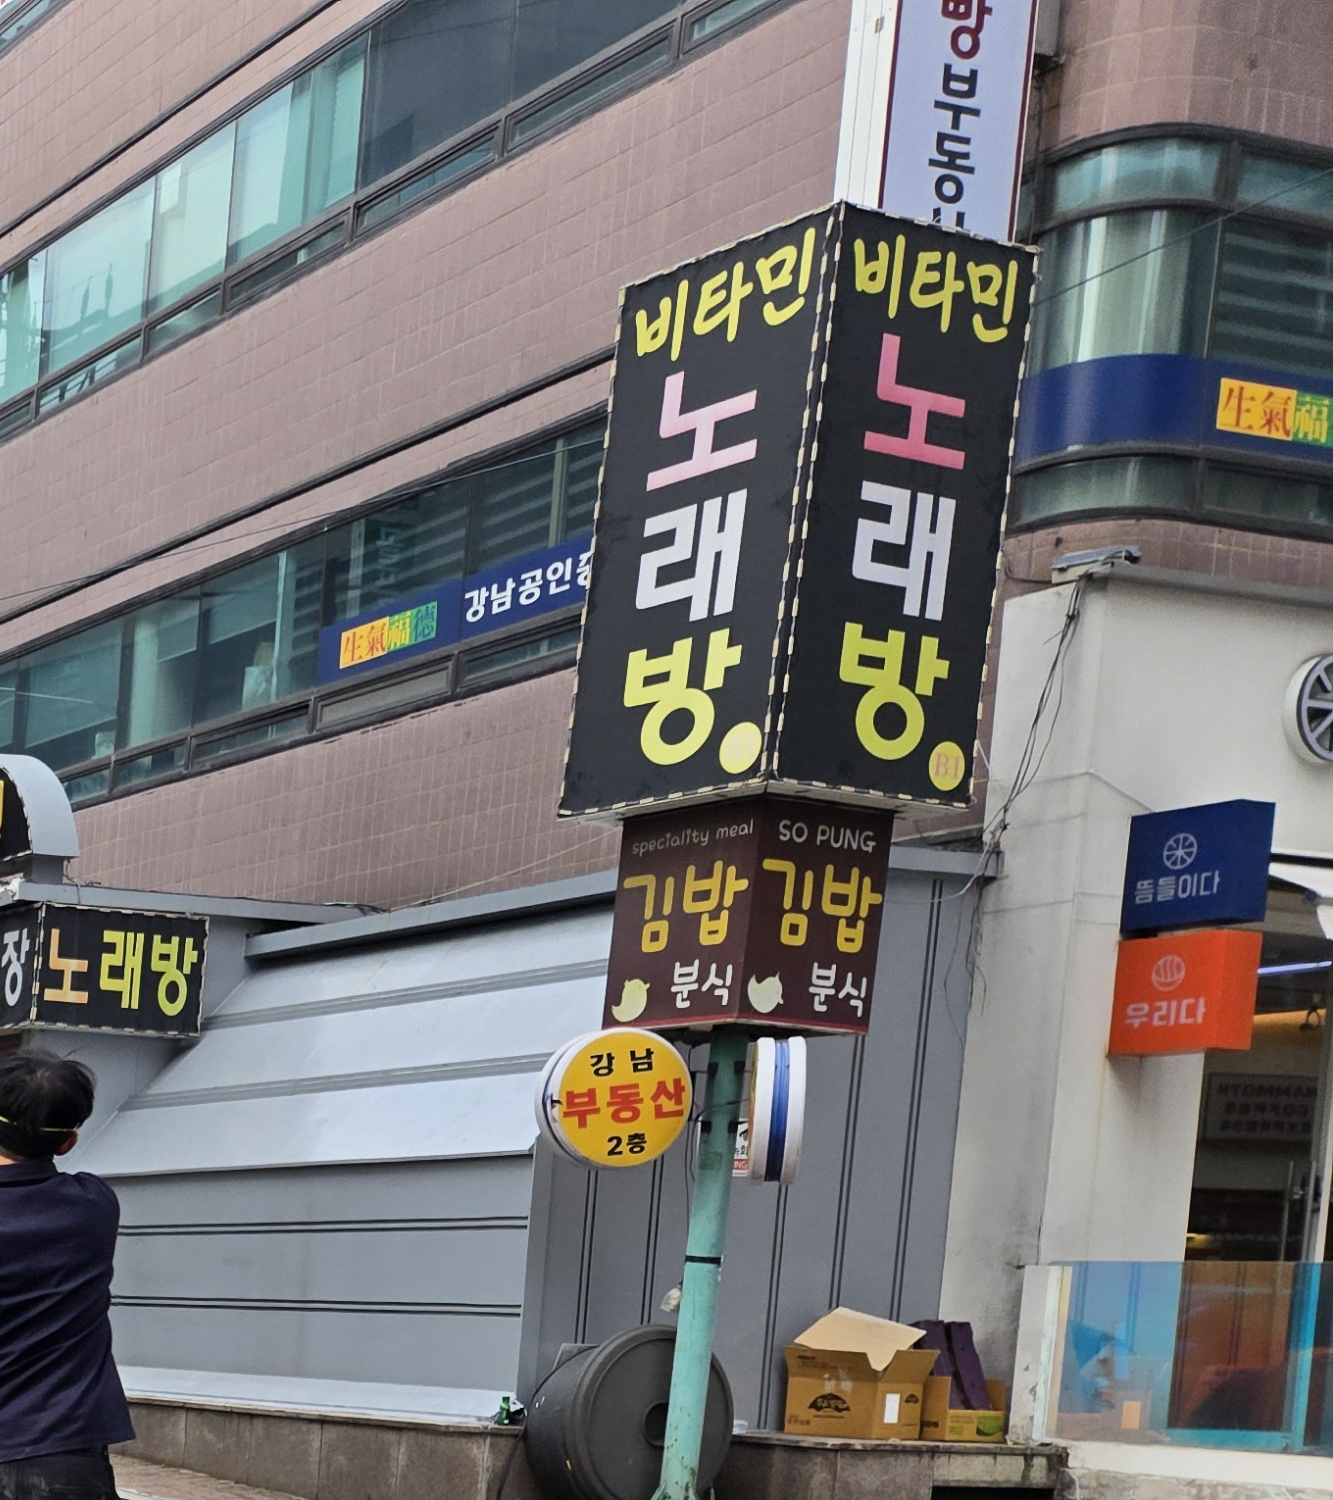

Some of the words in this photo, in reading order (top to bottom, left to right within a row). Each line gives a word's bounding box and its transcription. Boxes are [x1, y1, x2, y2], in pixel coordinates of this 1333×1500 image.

[635, 226, 816, 361] 비타민
[853, 234, 1018, 343] 비타민
[622, 370, 758, 766] 노래방
[839, 332, 967, 761] 노래방
[935, 752, 960, 780] B1
[632, 828, 709, 857] speciality
[716, 818, 754, 841] meal
[778, 819, 808, 843] SO
[816, 824, 876, 854] PUNG
[623, 860, 749, 953] 김밥
[762, 858, 883, 954] 김밥
[43, 927, 198, 1017] 노래방
[670, 958, 733, 1009] 분식
[808, 961, 867, 1018] 분식
[1125, 995, 1206, 1029] 우리다
[563, 1077, 686, 1129] 부동산
[607, 1132, 647, 1156] 2층
